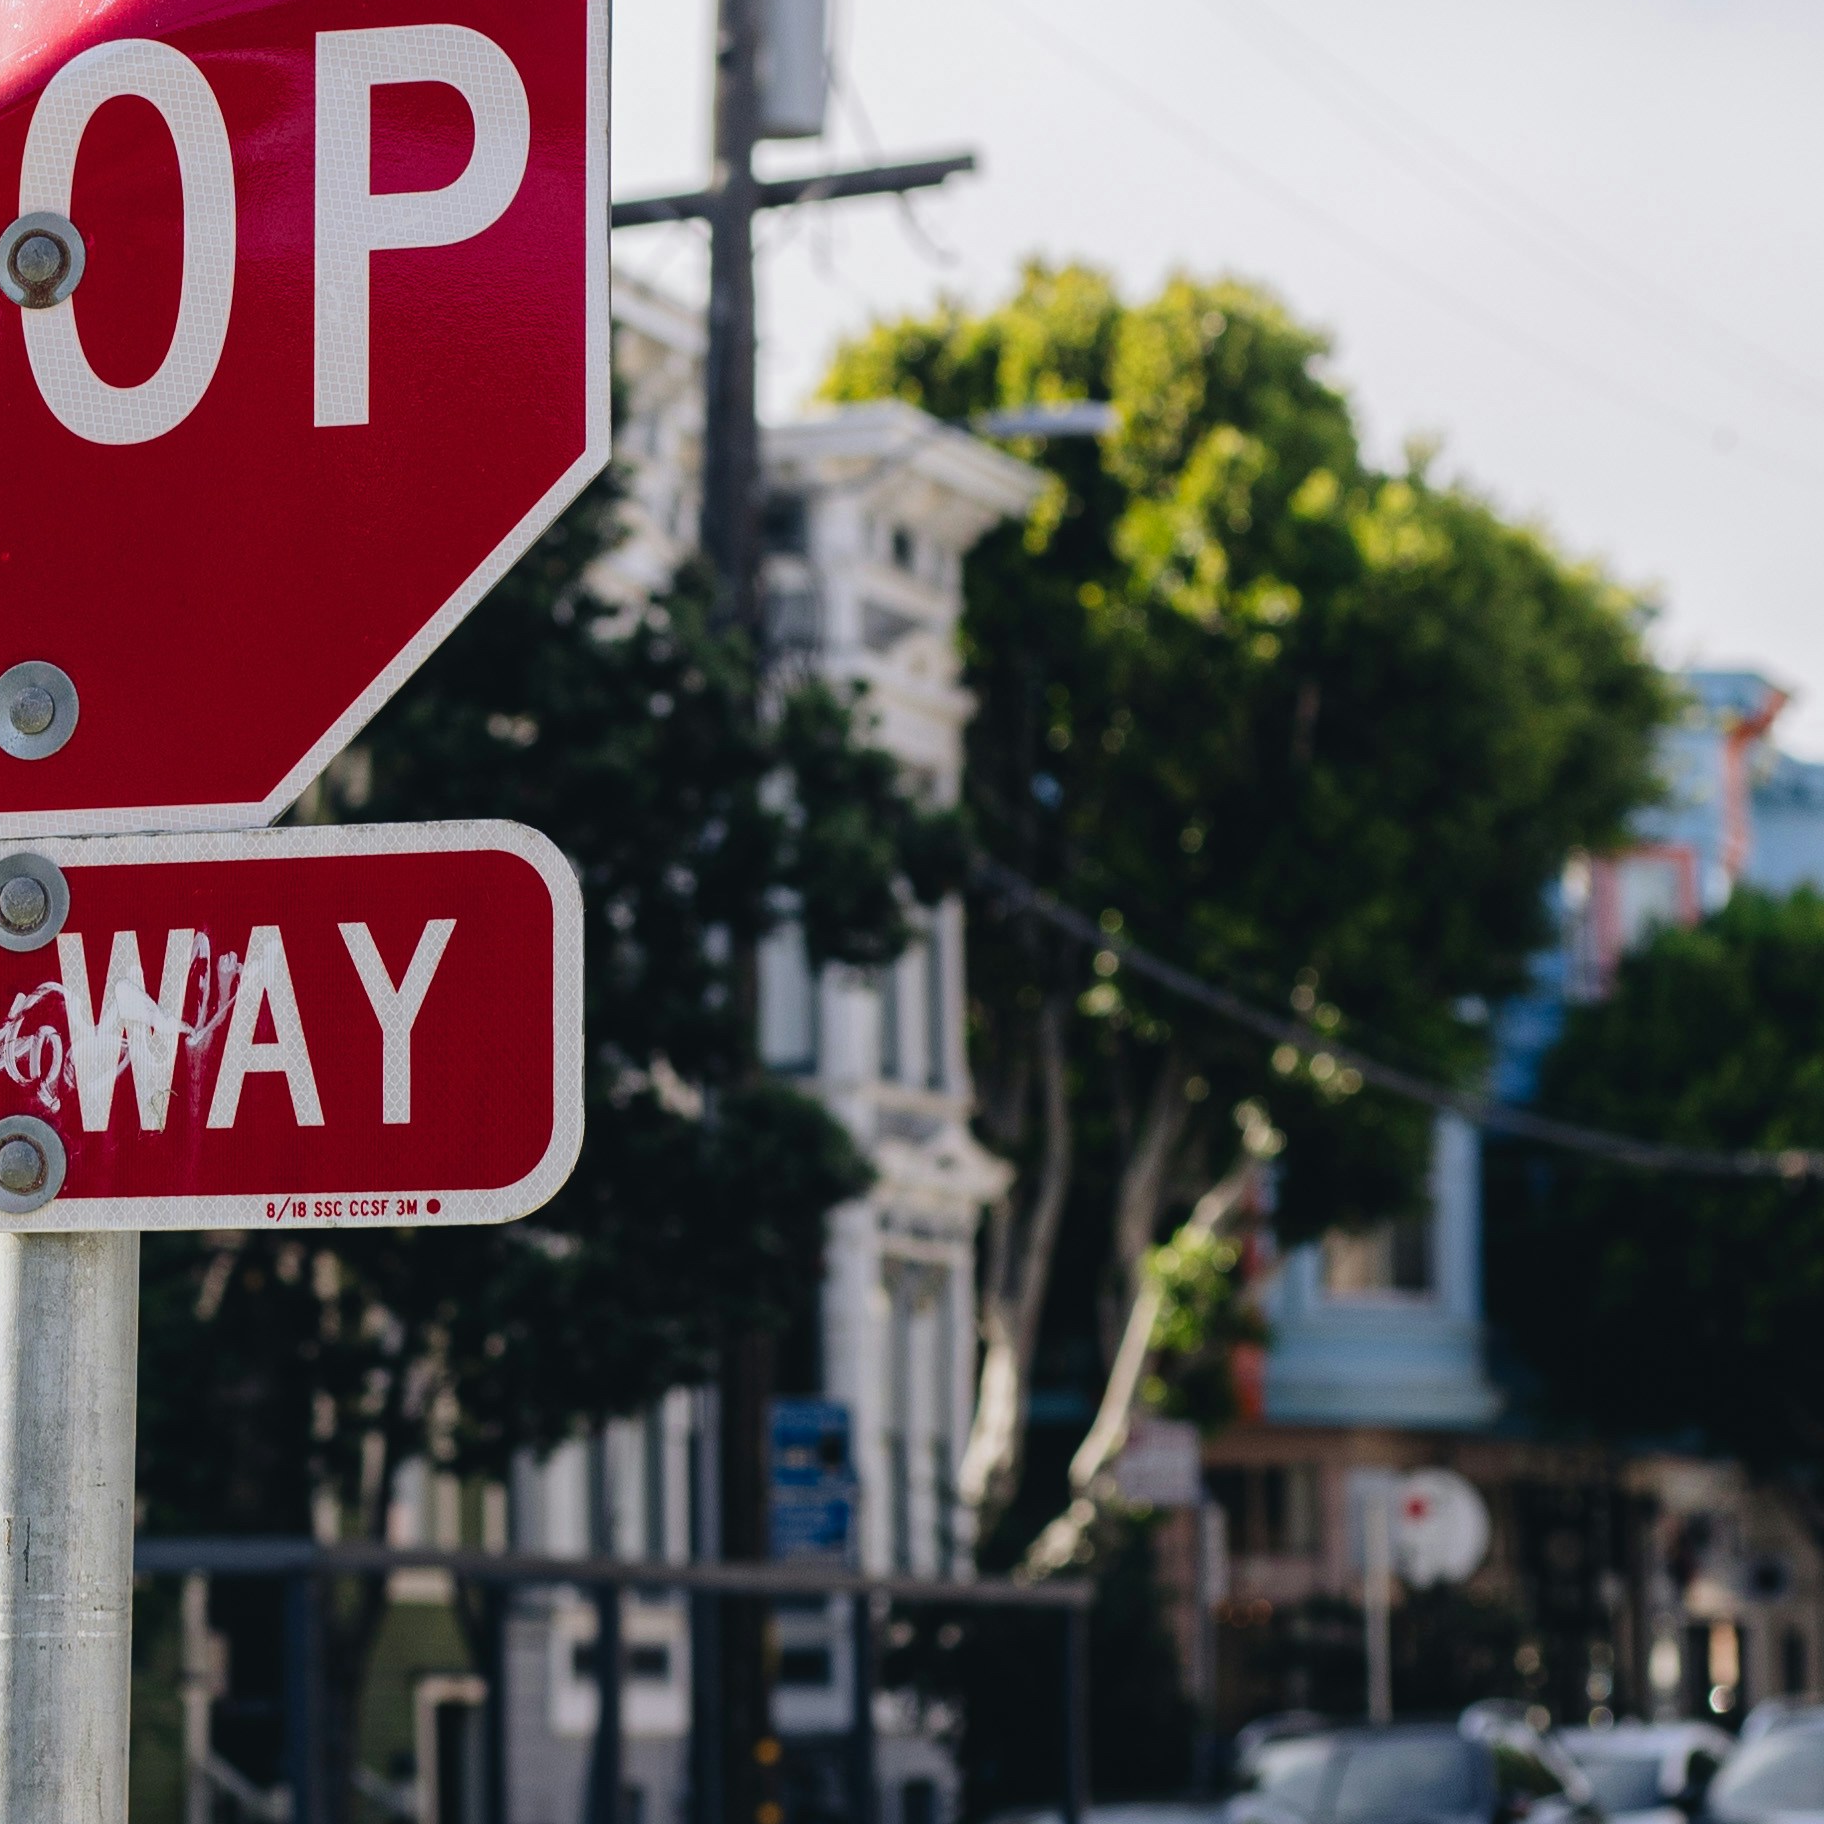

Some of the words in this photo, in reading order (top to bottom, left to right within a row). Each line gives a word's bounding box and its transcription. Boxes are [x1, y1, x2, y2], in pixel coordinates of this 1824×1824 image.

[56, 918, 458, 1133] WAY
[266, 1196, 307, 1222] 8/18
[314, 1200, 343, 1217] SSC
[349, 1199, 389, 1217] CCSF
[396, 1199, 418, 1216] 3M
